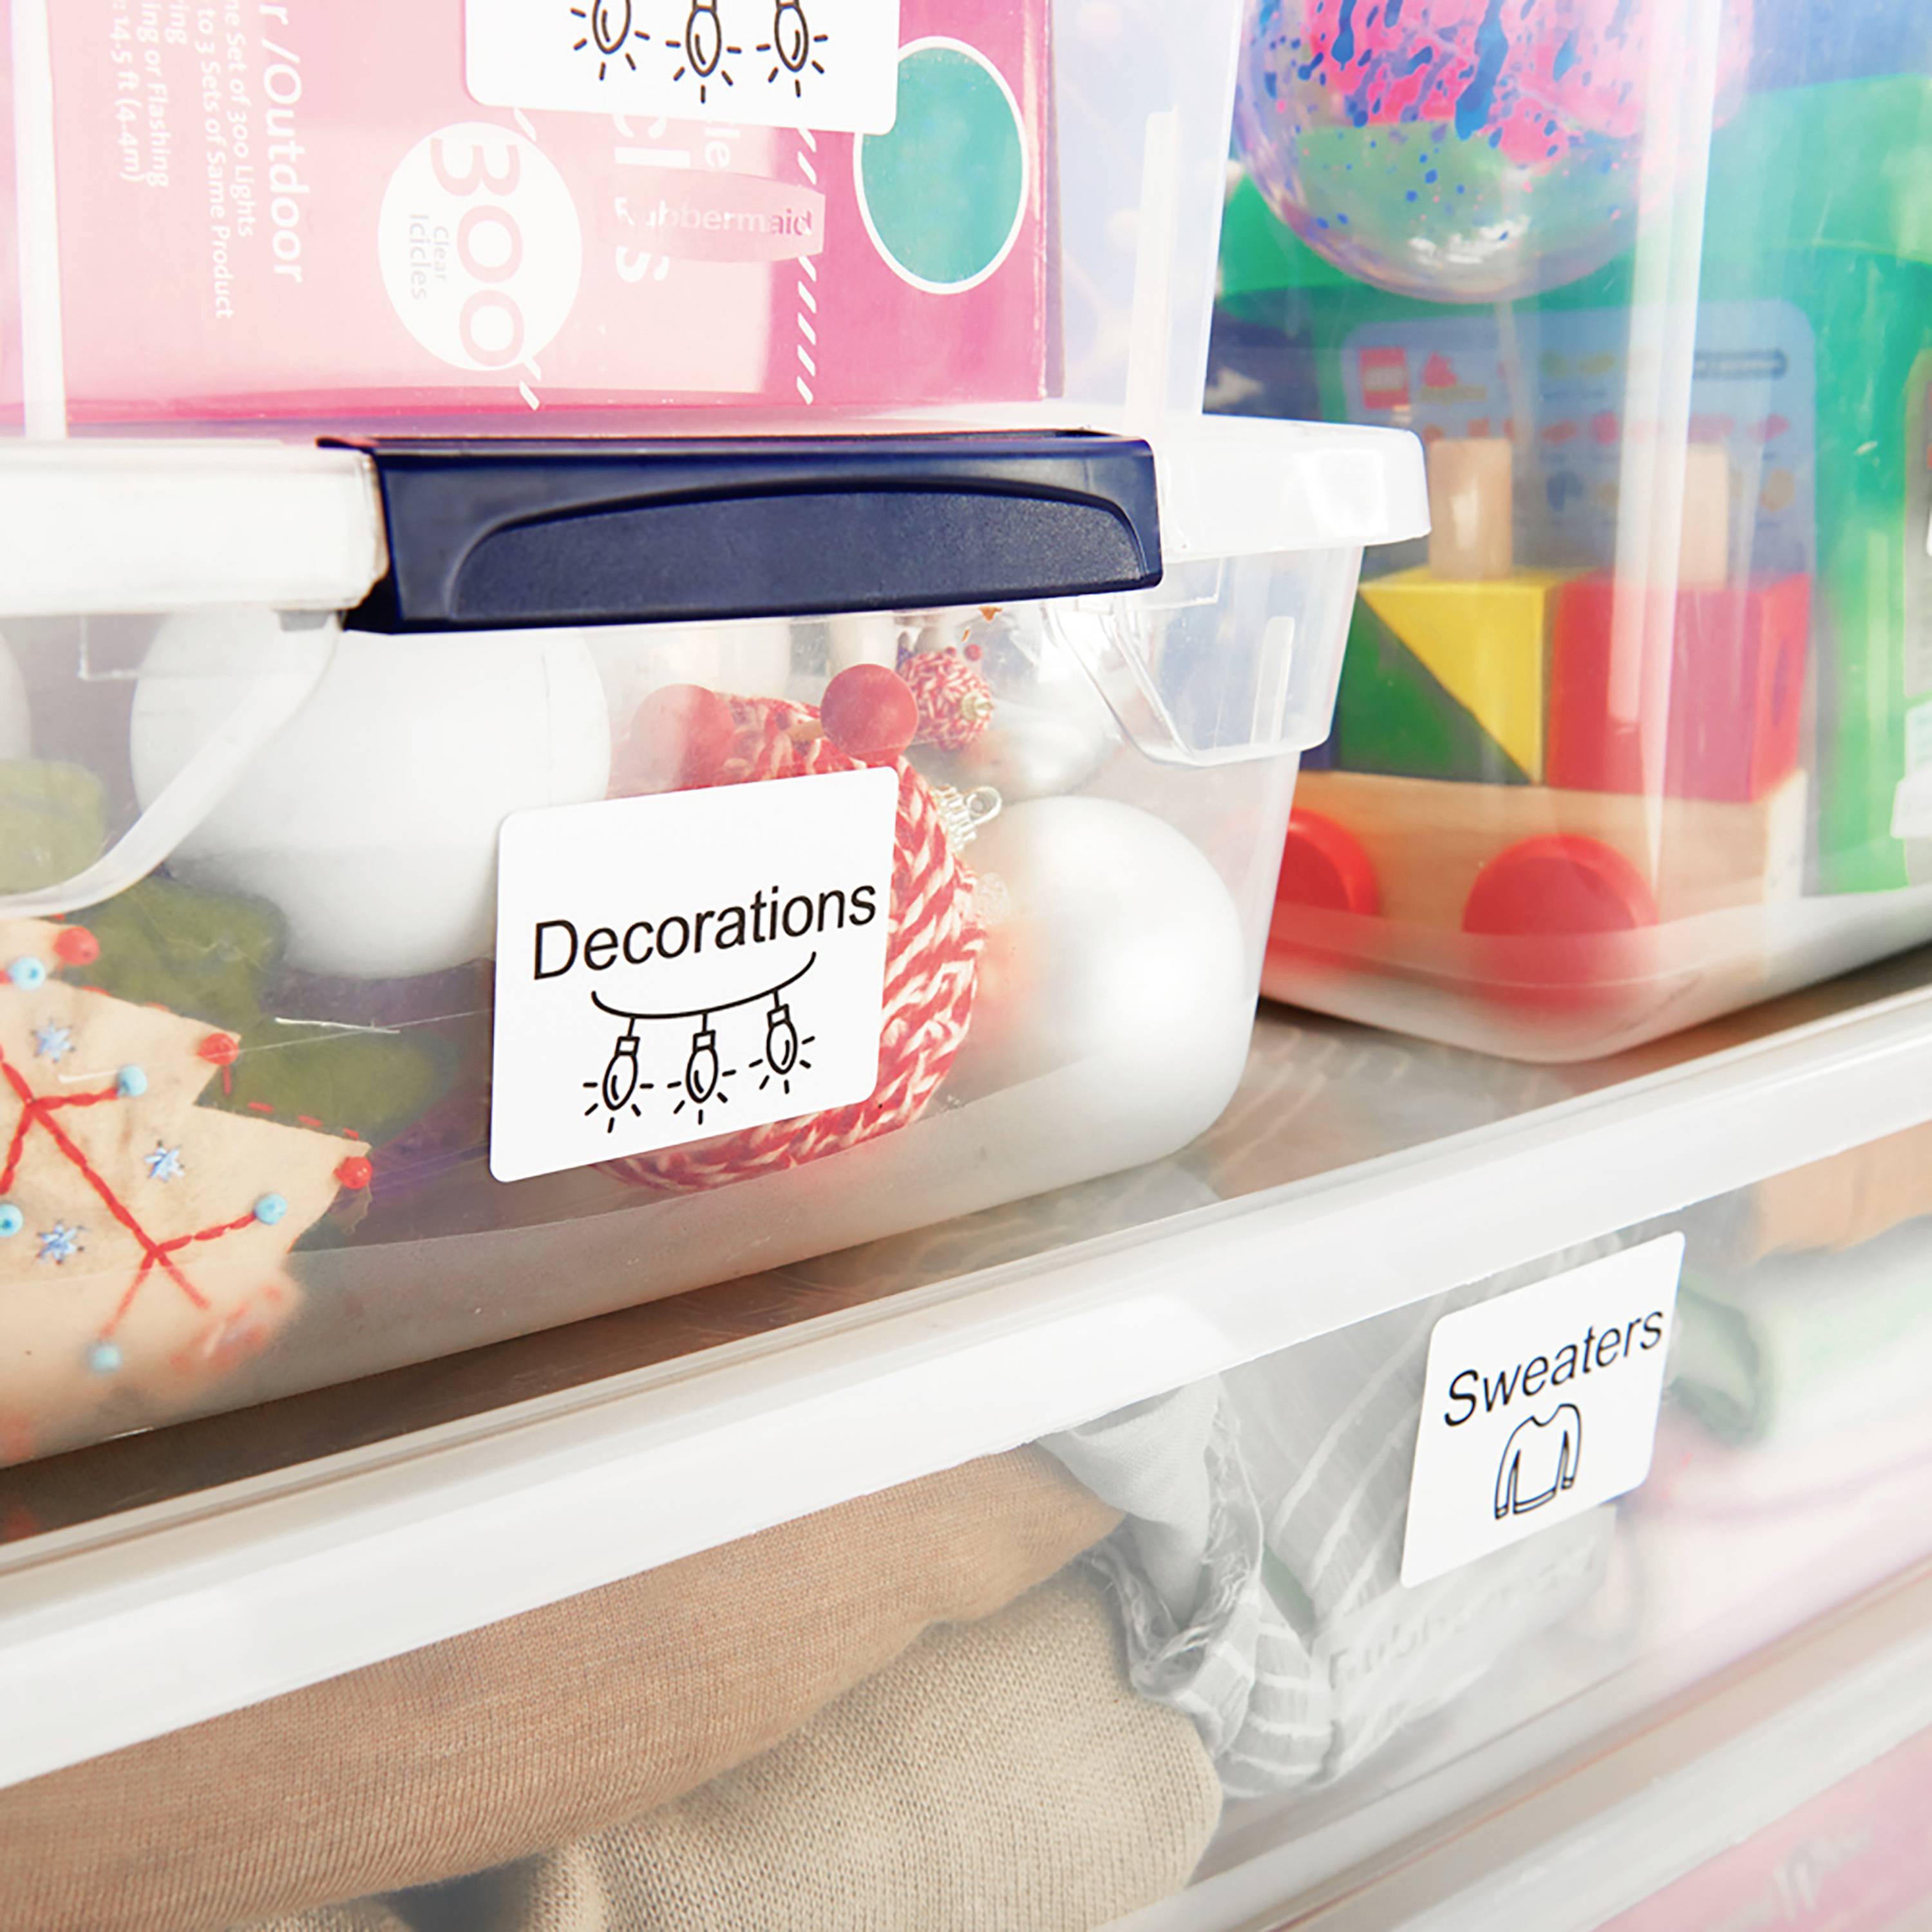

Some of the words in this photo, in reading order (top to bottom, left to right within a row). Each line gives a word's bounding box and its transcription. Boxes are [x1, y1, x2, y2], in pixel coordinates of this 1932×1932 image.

[109, 15, 134, 63] 14.5
[195, 41, 216, 54] 3
[197, 8, 217, 35] to
[144, 49, 162, 77] or
[226, 33, 247, 72] Set
[117, 70, 140, 90] ft
[201, 61, 223, 113] Sets
[229, 79, 252, 107] of
[115, 99, 146, 182] (4.4m)
[146, 82, 172, 187] Flashing
[205, 118, 228, 147] of
[227, 109, 249, 158] 300
[207, 151, 227, 220] Same
[229, 165, 256, 238] Lights
[211, 225, 234, 319] Product
[409, 214, 432, 301] Icicles
[430, 137, 525, 367] 300
[433, 225, 450, 282] clear
[534, 885, 876, 981] Decorations
[1444, 1310, 1663, 1427] Sweaters
